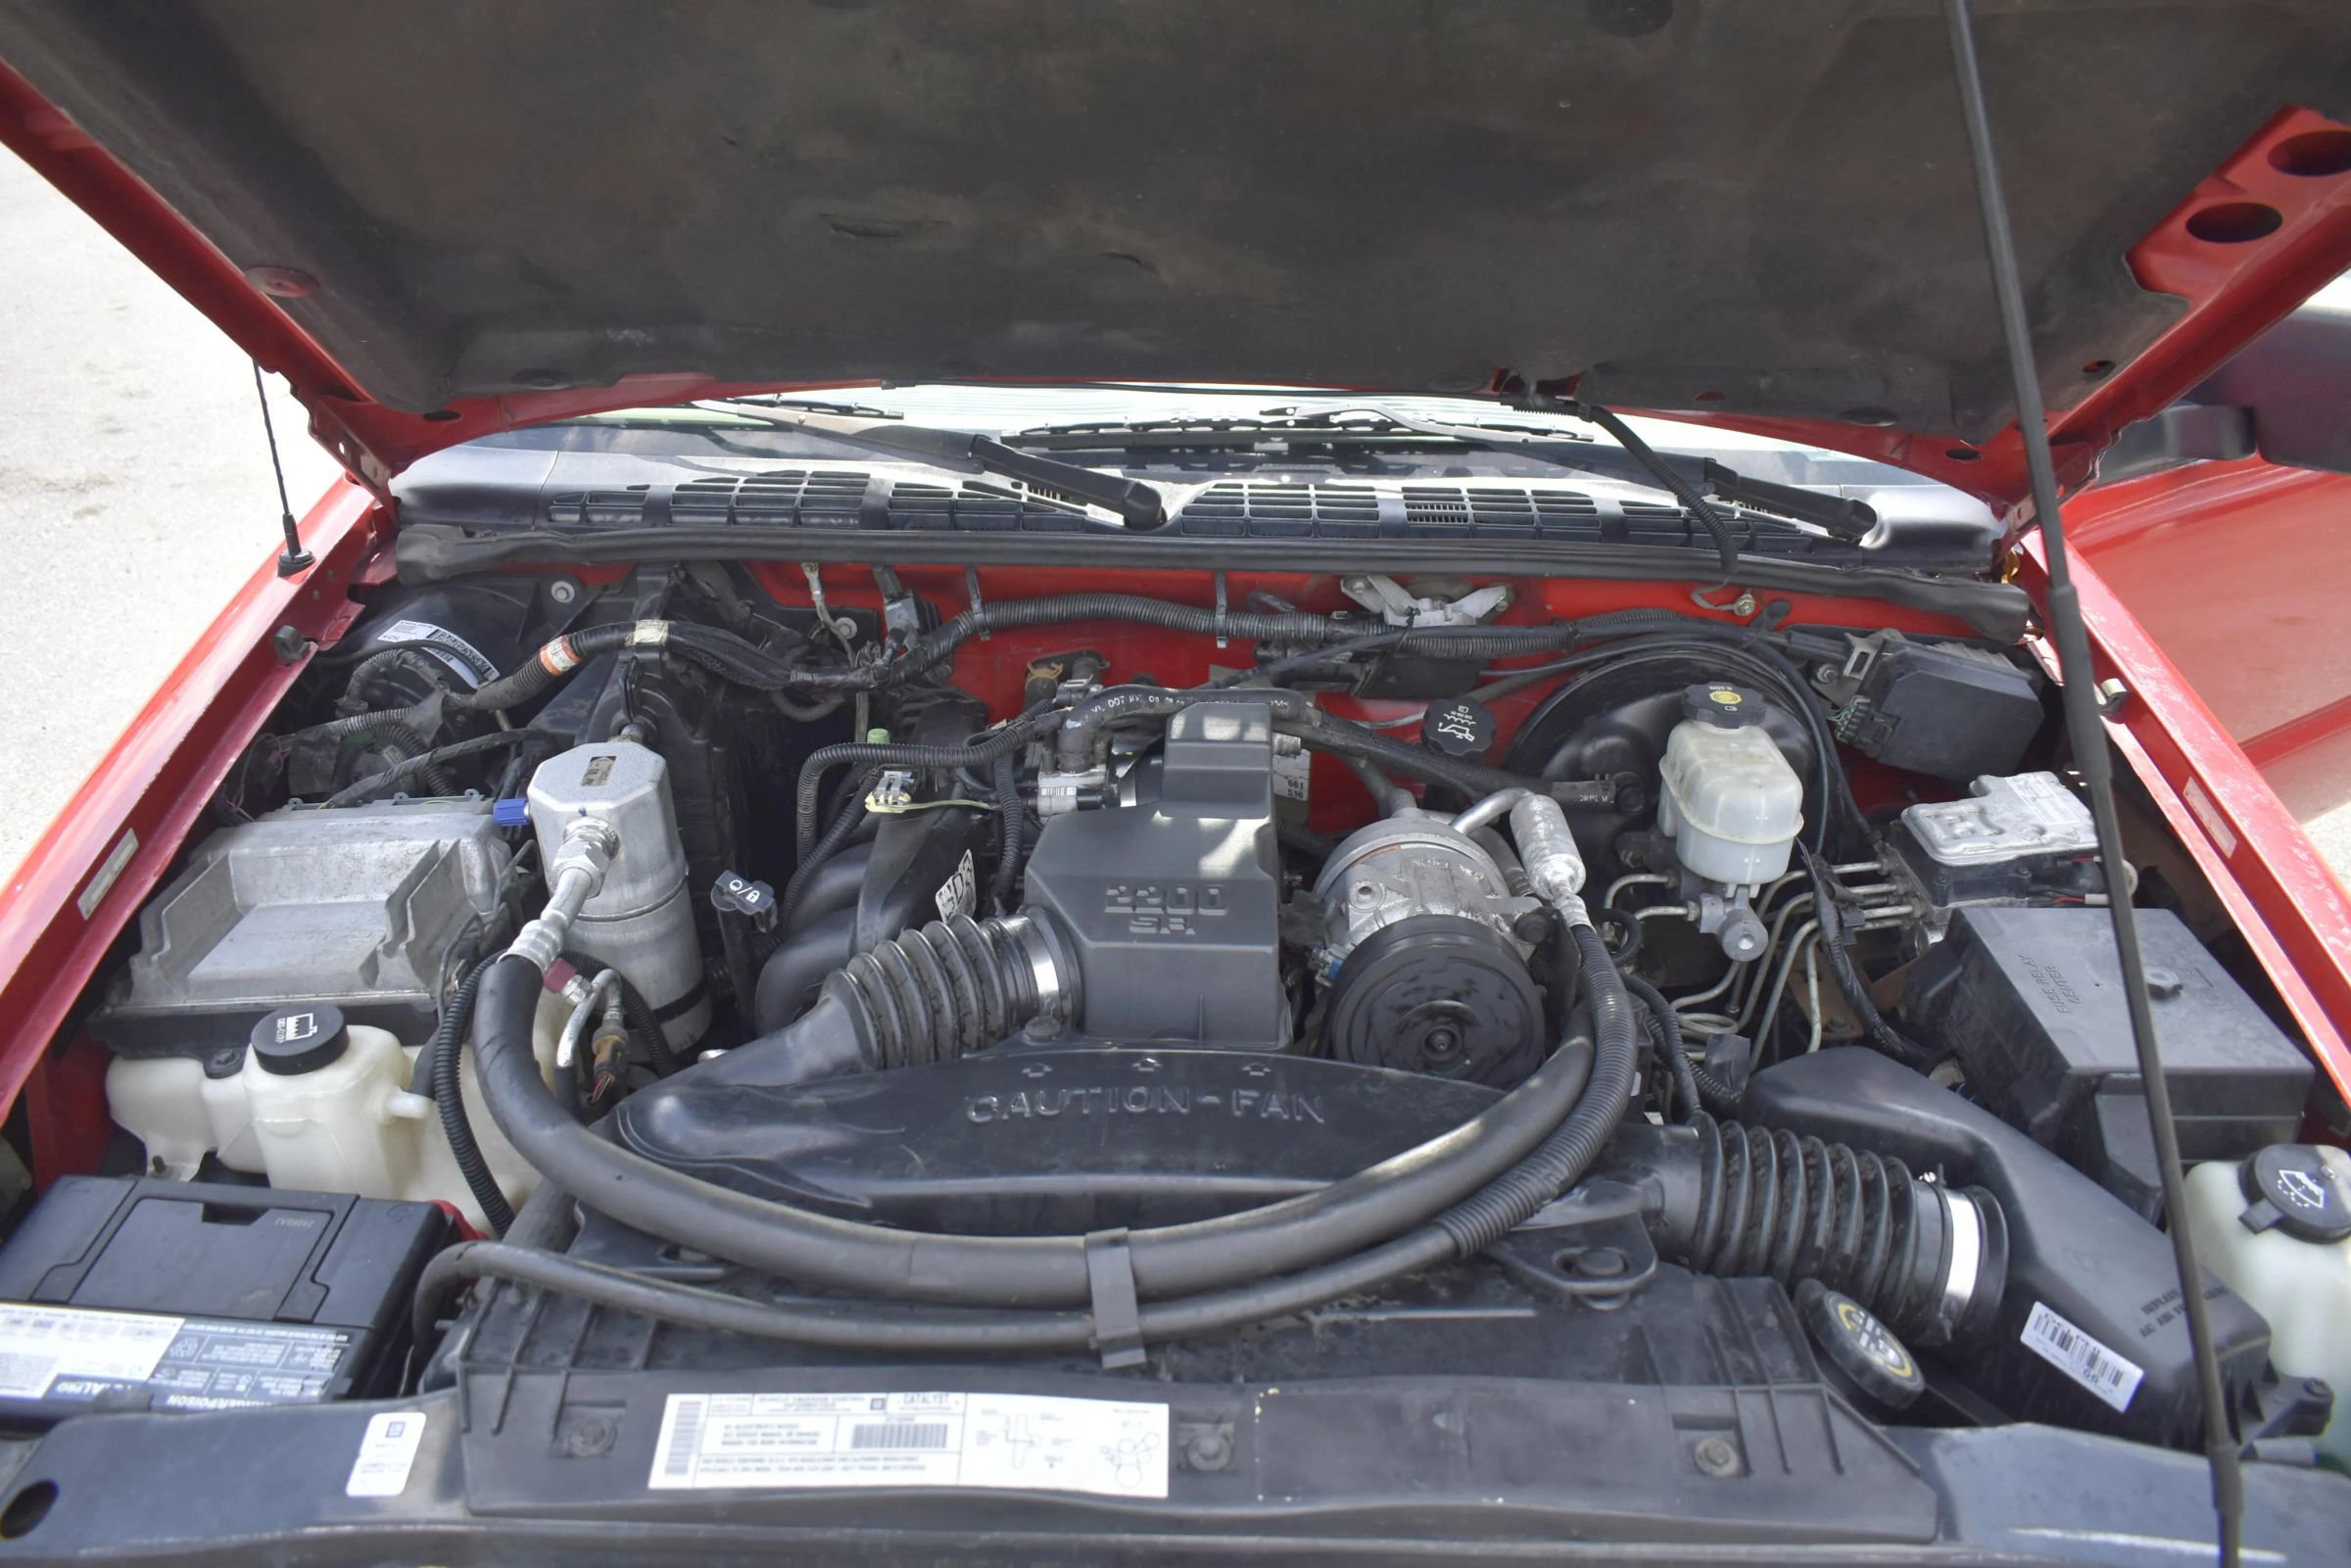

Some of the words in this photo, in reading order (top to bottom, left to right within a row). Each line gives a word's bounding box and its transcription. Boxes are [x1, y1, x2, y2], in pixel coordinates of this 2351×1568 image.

[1104, 884, 1228, 916] 2200
[2018, 954, 2050, 986] RELAY
[2044, 965, 2083, 1004] CENTER
[2040, 987, 2074, 1014] FUSE
[966, 1086, 1190, 1122] CAUTION
[1231, 1089, 1324, 1124] FAN
